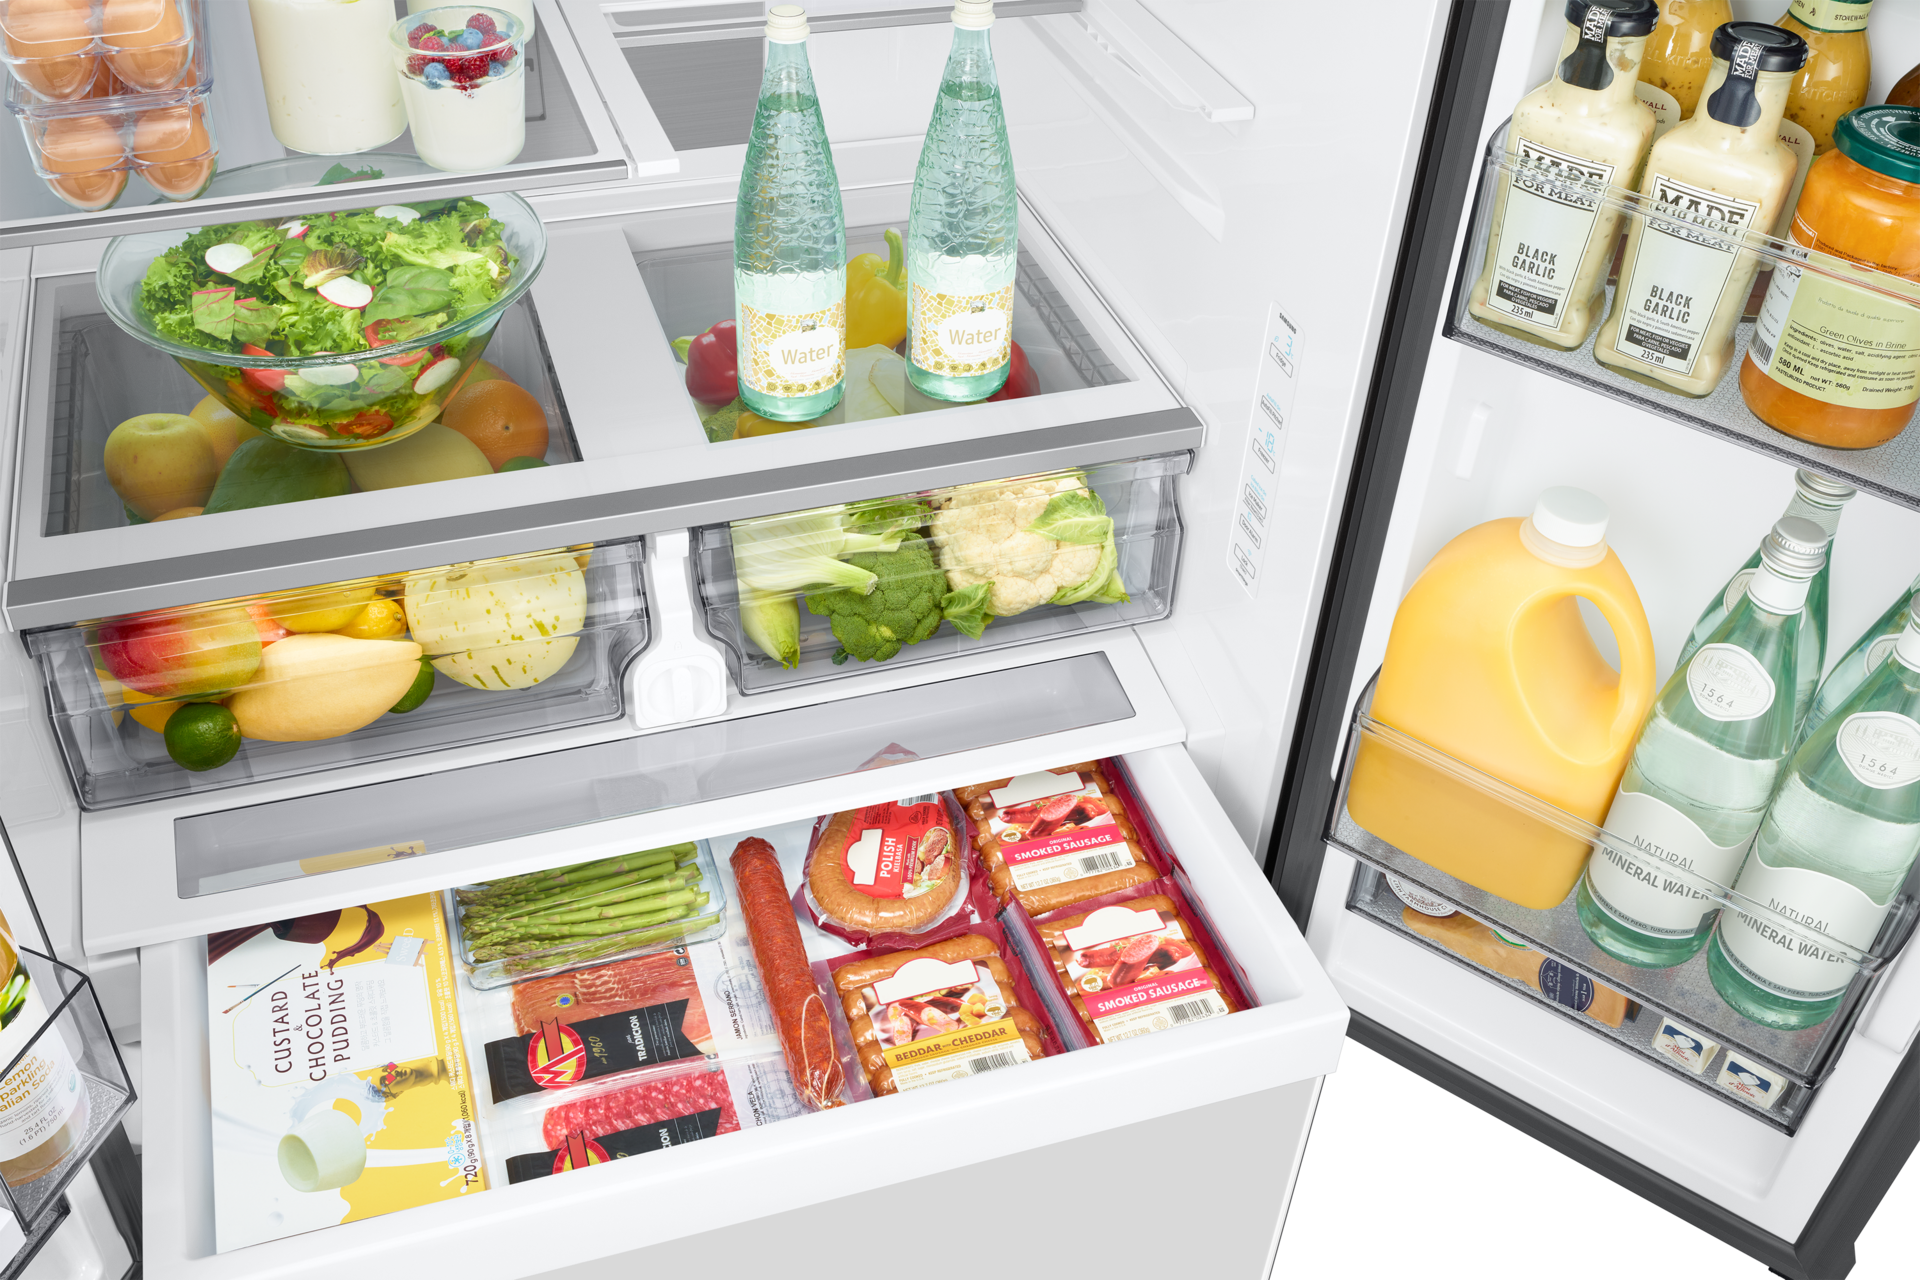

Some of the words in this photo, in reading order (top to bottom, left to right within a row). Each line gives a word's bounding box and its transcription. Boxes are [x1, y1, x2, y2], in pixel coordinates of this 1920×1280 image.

[1583, 4, 1603, 40] MADE
[1594, 27, 1602, 42] FOR
[1733, 39, 1754, 77] MADE
[1744, 64, 1753, 78] FOR
[1779, 134, 1800, 144] ALL
[1659, 188, 1745, 225] MADE
[1517, 242, 1557, 266] BLACK
[1511, 255, 1556, 280] GARLIC
[1650, 285, 1693, 309] BLACK
[1279, 312, 1296, 334] SAMSUNG
[1511, 304, 1524, 315] 235
[1524, 309, 1534, 318] ml
[1643, 298, 1690, 324] GARLIC
[948, 325, 1002, 346] Water
[1632, 332, 1645, 340] PARA
[1660, 342, 1681, 353] PESCADO
[1645, 342, 1669, 354] VEGETALES
[1668, 339, 1688, 350] VEGGIES
[1820, 326, 1845, 340] Green
[1847, 335, 1873, 346] Olives
[781, 341, 834, 365] Water
[1275, 352, 1286, 368] Fridge
[1641, 349, 1654, 361] 235
[1655, 355, 1665, 364] ml
[1775, 366, 1802, 383] PASTEURIZED
[1779, 357, 1791, 369] 580
[1792, 364, 1804, 376] ML
[1835, 382, 1850, 391] 560g
[1258, 447, 1270, 464] Freezer
[1241, 519, 1250, 530] Door
[1249, 529, 1259, 543] Alarm
[1014, 845, 1061, 860] SMOKED
[1064, 835, 1112, 850] SAUSAGE
[1049, 836, 1072, 845] ORIGINAL
[1633, 834, 1694, 872] NATURAL
[880, 837, 896, 878] POLISH
[893, 844, 903, 872] KIELBASA
[1602, 846, 1659, 888] MINERAL
[1662, 879, 1713, 900] WATER
[1618, 912, 1630, 922] SAN
[1650, 926, 1677, 934] TUSCANY
[1768, 898, 1830, 935] NATURAL
[1736, 910, 1794, 951] MINERAL
[1797, 942, 1847, 963] WATER
[1134, 982, 1158, 991] ORIGINAL
[1740, 964, 1766, 984] SCARPERIA
[1773, 984, 1786, 992] SAN
[724, 990, 738, 1018] SERRANO
[1098, 992, 1147, 1012] SMOKED
[1150, 978, 1200, 998] SAUSAGE
[270, 990, 293, 1073] CUSTARD
[302, 970, 327, 1082] CHOCOLATE
[327, 978, 351, 1062] PUDDING
[732, 1018, 743, 1040] JAMON
[629, 1015, 647, 1060] TRADICION
[895, 1043, 942, 1062] BEDDAR
[952, 1027, 1007, 1047] CHEDDAR
[32, 1060, 55, 1090] Soda
[19, 1135, 33, 1146] (1.6
[34, 1126, 47, 1136] PT)
[46, 1114, 57, 1126] 750
[24, 1122, 40, 1135] 25.4
[40, 1116, 48, 1124] FL
[48, 1106, 56, 1116] OZ
[463, 1164, 478, 1186] 720
